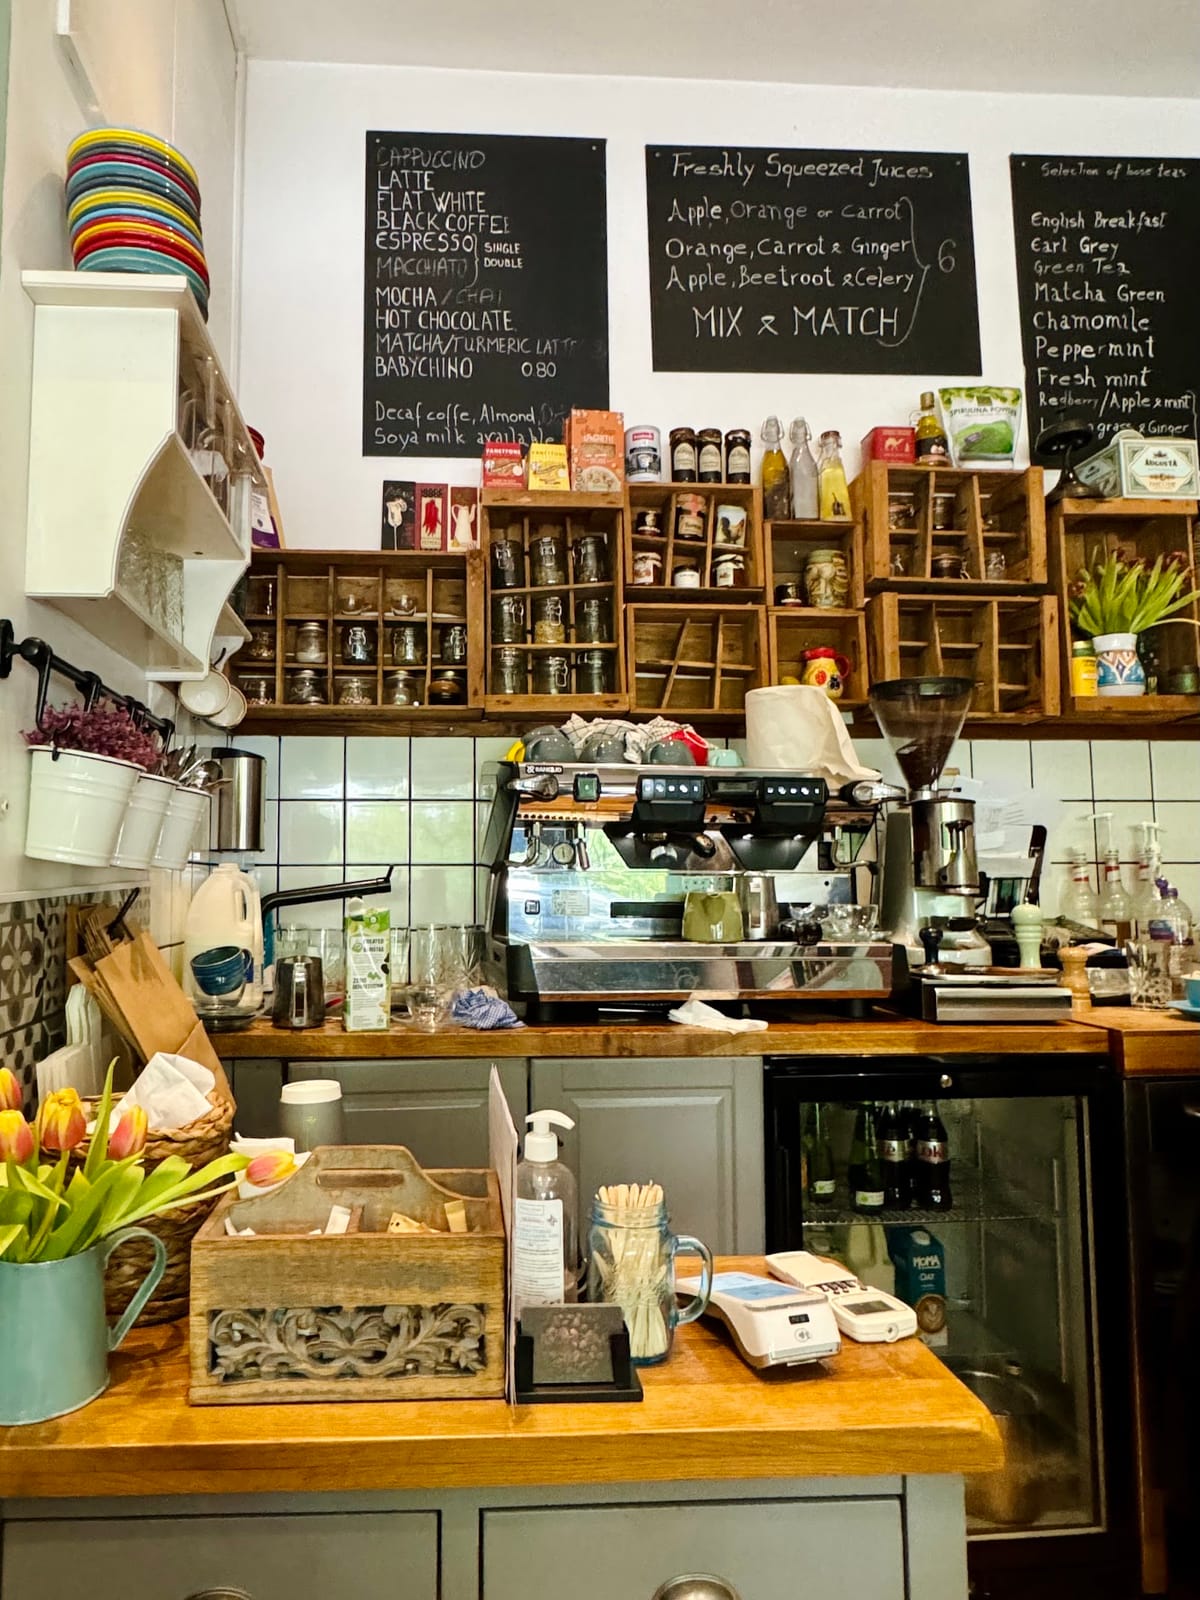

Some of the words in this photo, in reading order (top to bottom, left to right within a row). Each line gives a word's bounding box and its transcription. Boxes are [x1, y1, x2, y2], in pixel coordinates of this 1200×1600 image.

[375, 147, 486, 170] CAPPUCCINO
[672, 152, 754, 186] Freshly
[764, 153, 864, 188] Squeezed
[868, 158, 933, 188] Juices
[377, 170, 435, 191] LATTE
[1041, 162, 1099, 177] Selection
[1106, 163, 1122, 180] of
[1158, 163, 1187, 178] teas
[377, 190, 424, 212] FLAT
[431, 191, 486, 213] WHITE
[817, 208, 832, 219] or
[840, 201, 903, 221] Carrot
[376, 210, 440, 232] BLACK
[445, 214, 511, 235] COFFEE
[1030, 210, 1085, 234] English
[1093, 209, 1168, 235] Breakfast
[375, 231, 475, 252] ESPRESSO
[484, 242, 521, 255] SINGLE
[851, 236, 912, 262] Ginger
[1030, 236, 1067, 254] Earl
[1079, 235, 1120, 262] Grey
[484, 256, 524, 269] DOUBLE
[937, 238, 957, 274] 6
[1033, 260, 1085, 277] Green
[1092, 257, 1131, 276] Tea
[375, 256, 468, 280] MACCHIATO
[1034, 281, 1107, 303] Matcha
[1116, 283, 1166, 304] Green
[375, 309, 412, 331] HOT
[691, 305, 744, 338] MIX
[757, 315, 779, 337] &
[792, 305, 899, 337] MATCH
[1032, 306, 1151, 333] Chamomile
[1035, 335, 1155, 362] Peppermint
[375, 356, 474, 379] BABYCHINO
[1037, 365, 1097, 388] Fresh
[1104, 366, 1151, 388] mint
[1163, 394, 1192, 409] mint
[375, 400, 423, 428] Decaf
[374, 427, 419, 453] Soya
[425, 426, 466, 446] milk
